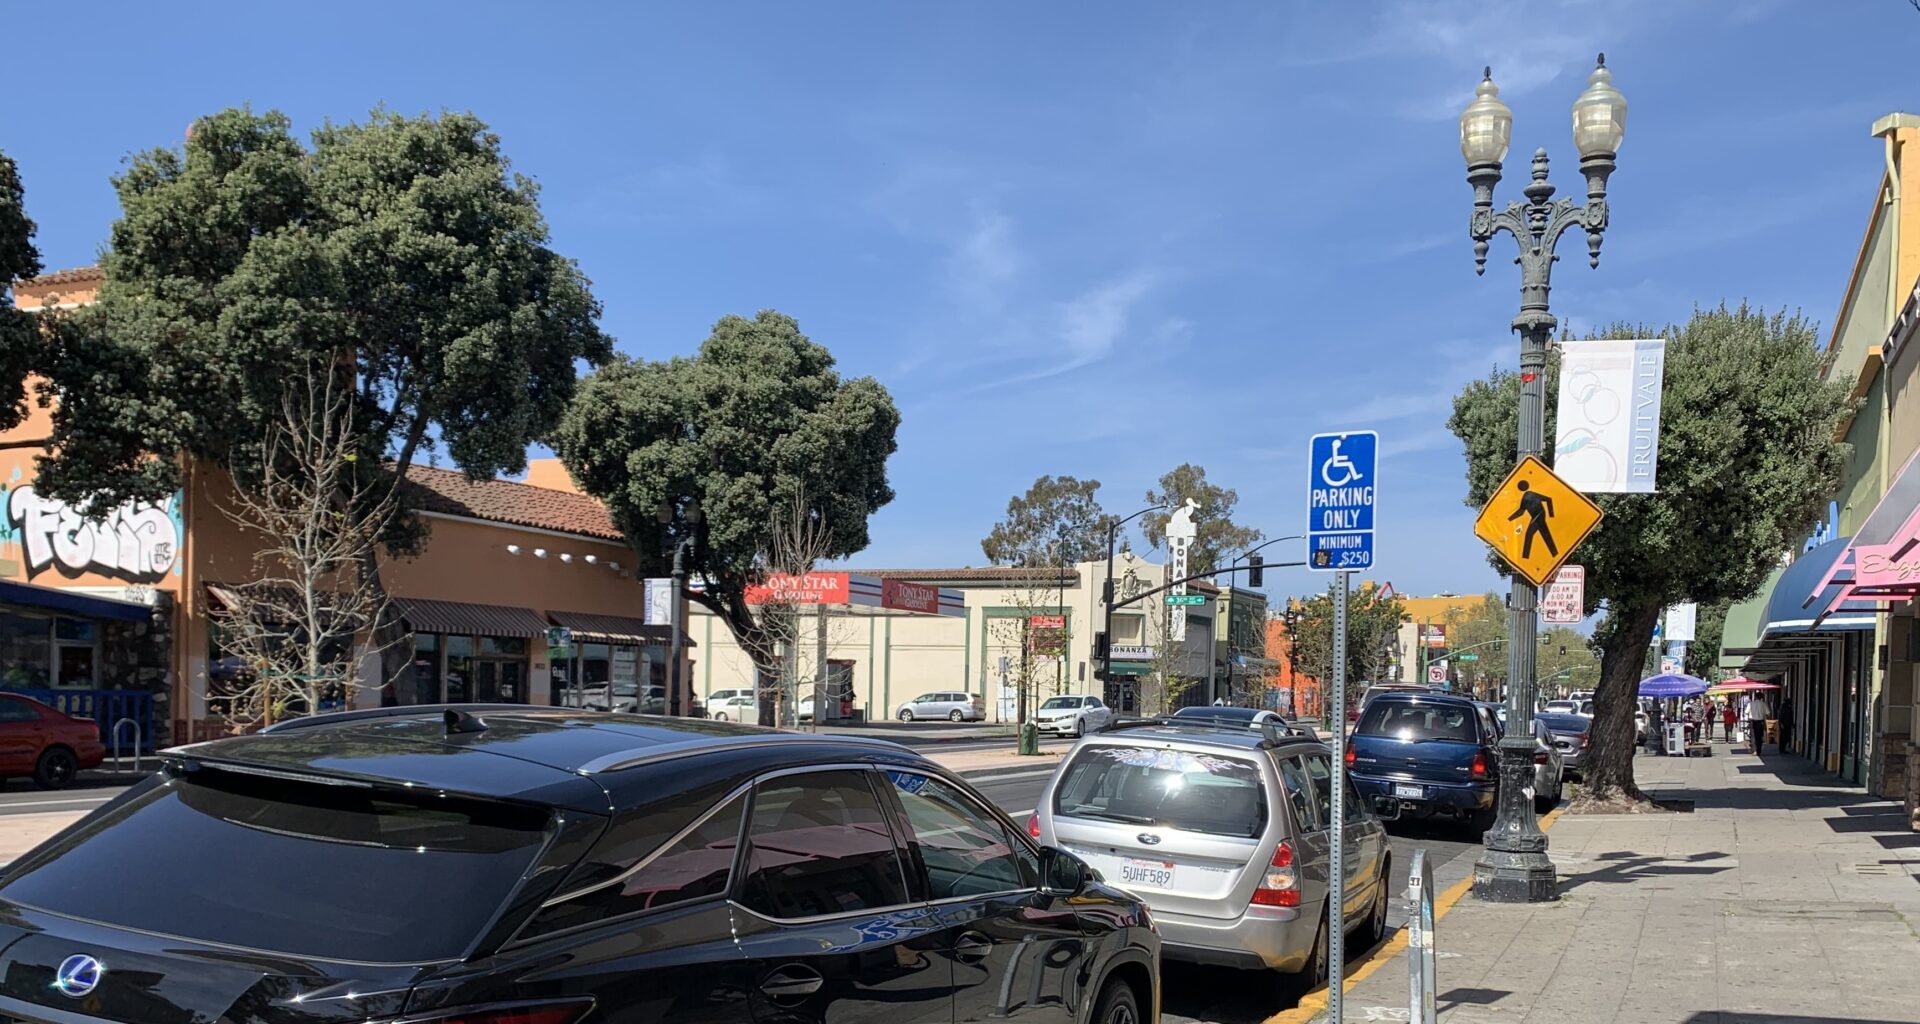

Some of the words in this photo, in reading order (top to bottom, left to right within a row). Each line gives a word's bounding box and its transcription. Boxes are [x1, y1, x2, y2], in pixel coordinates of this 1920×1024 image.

[1633, 355, 1657, 477] FRUITVALE
[1313, 486, 1372, 507] PARKING
[1324, 509, 1360, 529] ONLY
[1319, 536, 1361, 549] MINIMUM
[1341, 551, 1369, 565] $250
[804, 576, 839, 590] STAR
[898, 583, 918, 599] TONY
[918, 586, 934, 601] STAR
[905, 598, 928, 610] GASOLINE
[1122, 866, 1171, 884] 5UHF589
